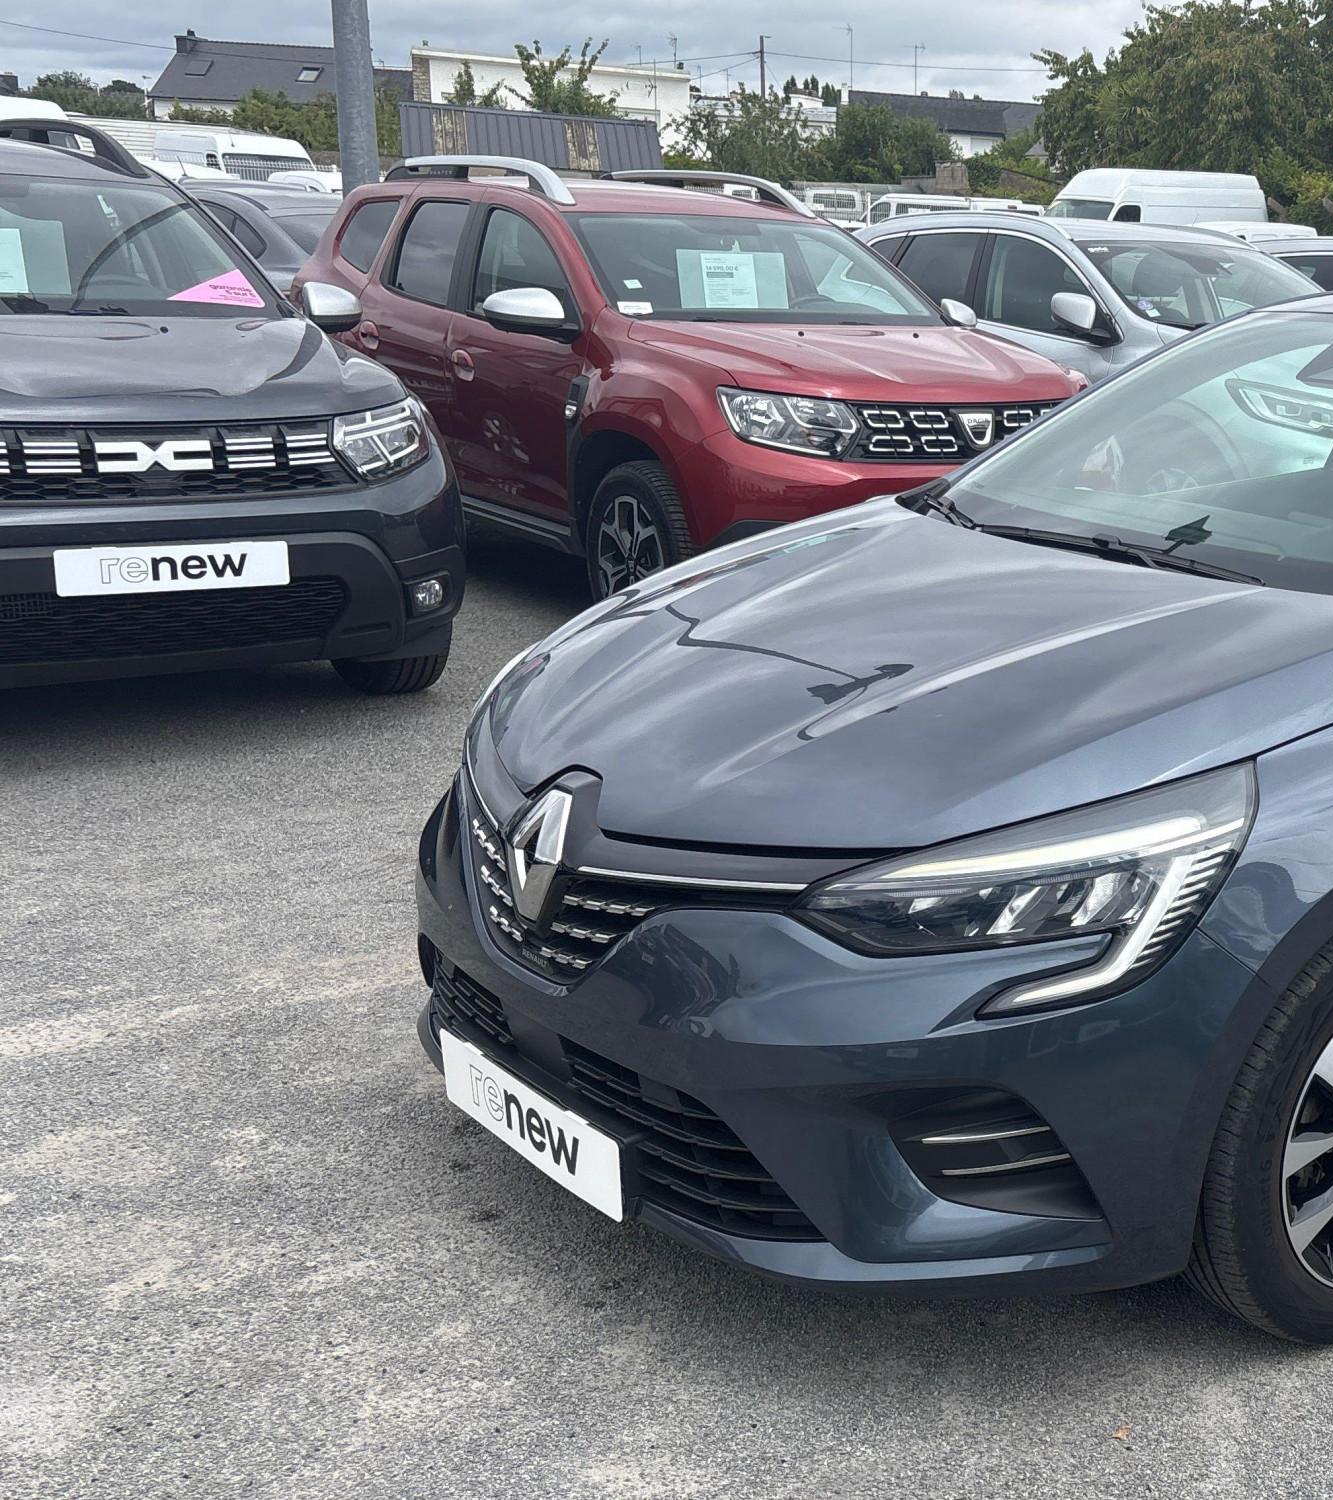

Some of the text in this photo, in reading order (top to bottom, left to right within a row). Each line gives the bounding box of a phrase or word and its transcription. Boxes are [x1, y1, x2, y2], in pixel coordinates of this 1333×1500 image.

[99, 552, 248, 584] renew
[522, 948, 548, 968] RENAULT
[469, 1064, 580, 1177] renew
